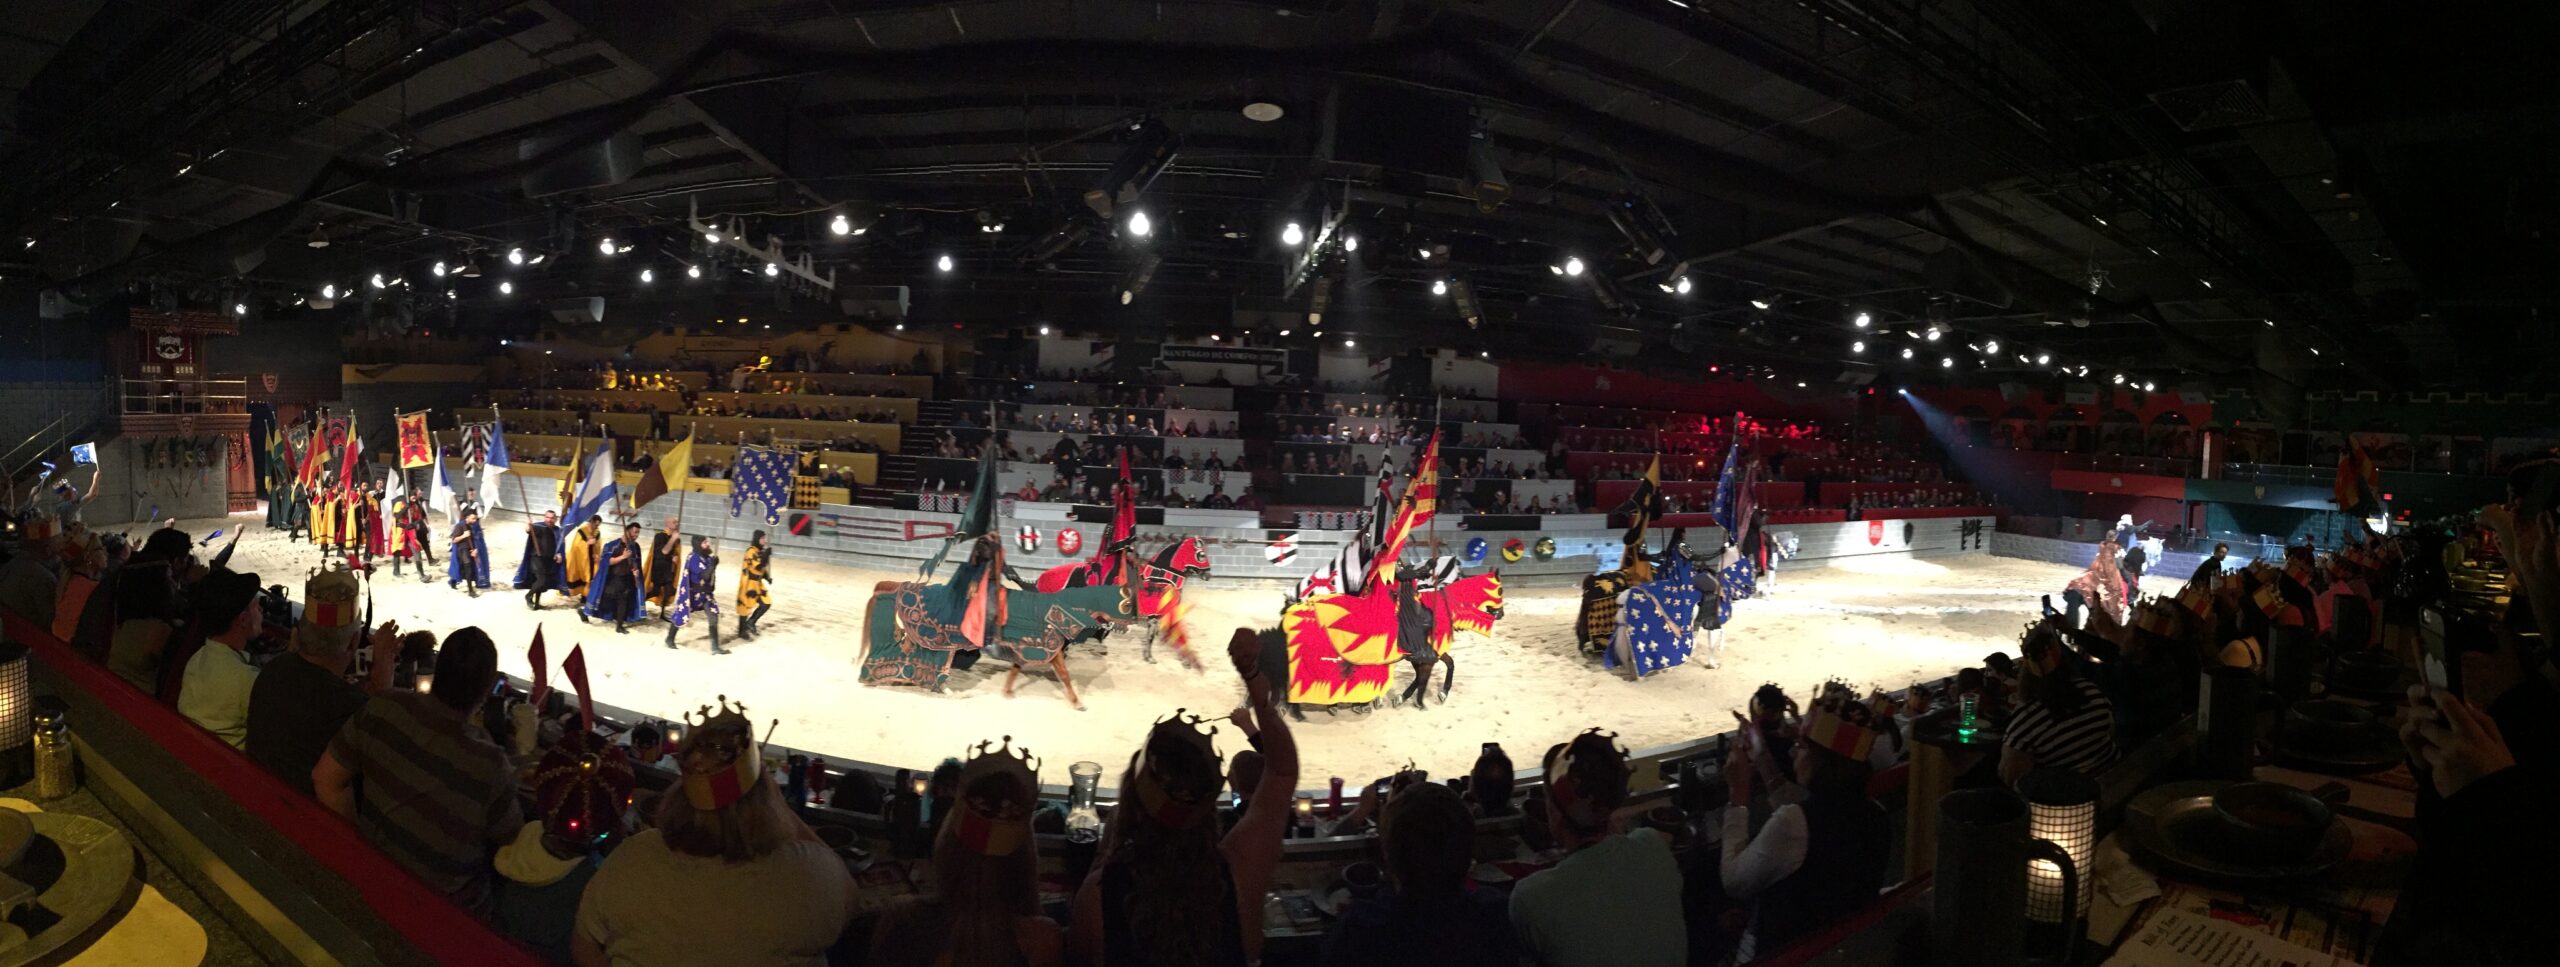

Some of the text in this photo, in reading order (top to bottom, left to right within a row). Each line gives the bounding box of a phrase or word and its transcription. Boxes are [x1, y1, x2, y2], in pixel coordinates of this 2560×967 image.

[1164, 350, 1283, 361] SANTIAGO DE COMPOTELA
